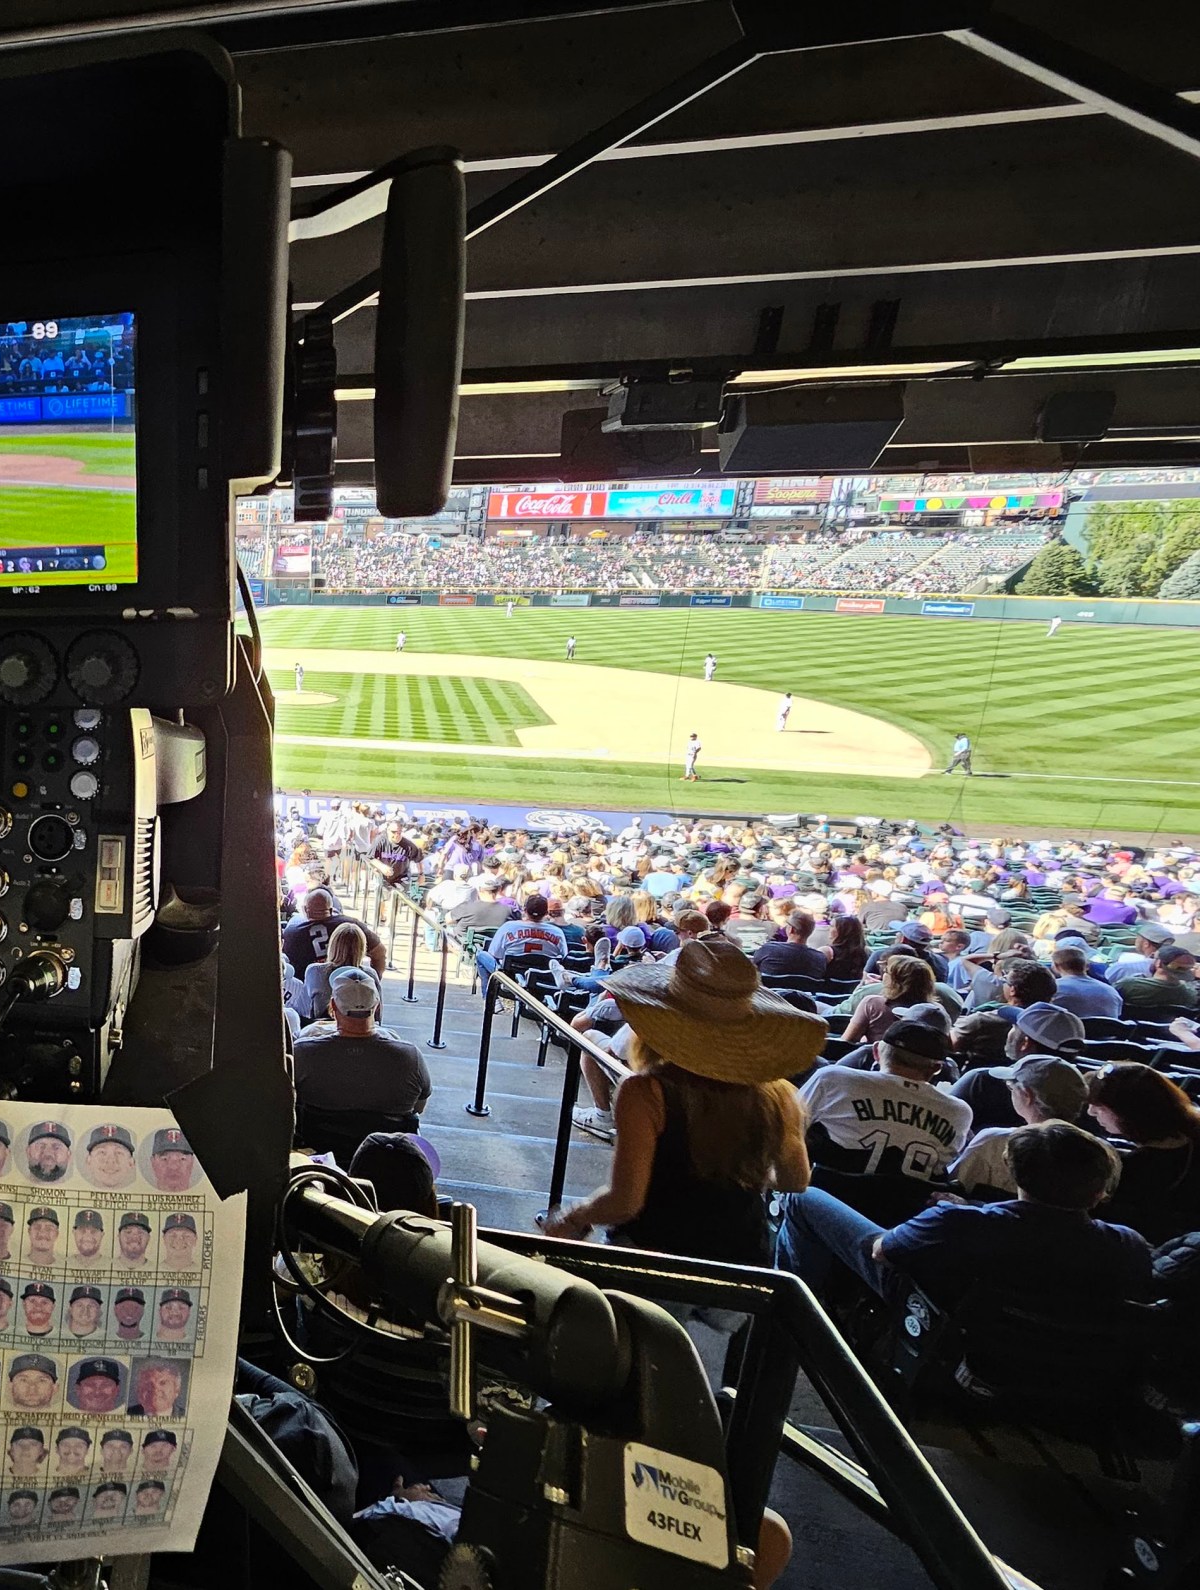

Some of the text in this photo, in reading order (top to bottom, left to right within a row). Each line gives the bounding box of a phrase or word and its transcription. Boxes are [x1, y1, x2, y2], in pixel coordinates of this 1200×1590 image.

[32, 321, 58, 340] 89
[514, 494, 574, 515] Coca-Cola
[6, 560, 15, 573] 2
[851, 1098, 957, 1147] BLACKMON
[104, 1201, 128, 1210] PITCH
[110, 1192, 132, 1201] MAKI
[147, 1195, 200, 1203] LUIS RAMIREZ
[202, 1229, 213, 1270] PITCHERS
[658, 1469, 701, 1494] Mobile
[660, 1484, 718, 1516] TV Group
[647, 1510, 702, 1542] 43FLEX
